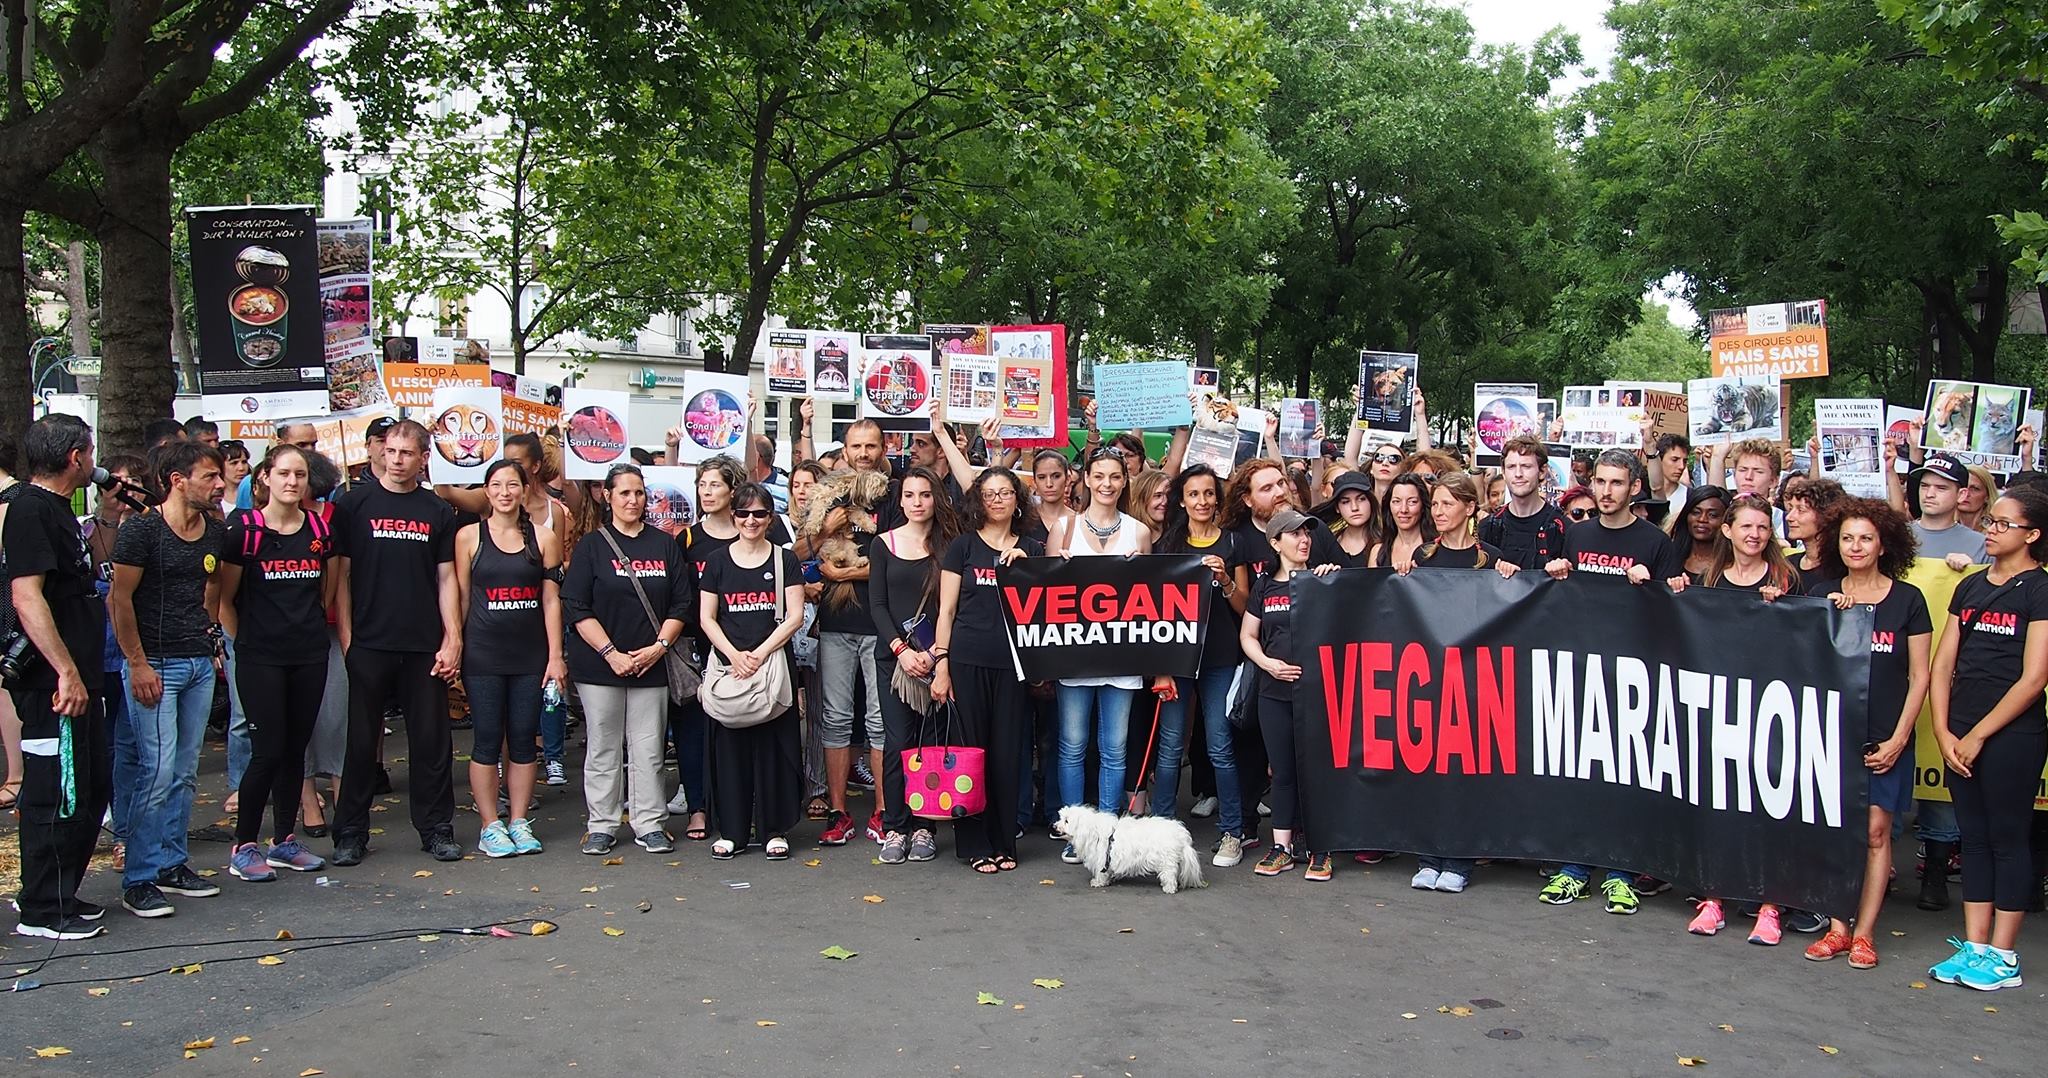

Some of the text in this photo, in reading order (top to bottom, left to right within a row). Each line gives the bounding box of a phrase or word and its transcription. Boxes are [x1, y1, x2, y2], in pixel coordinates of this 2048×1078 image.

[212, 219, 294, 228] CONSERVATION...
[275, 230, 296, 238] NON
[1719, 340, 1741, 351] DES
[1743, 336, 1792, 349] CIRQUES
[1719, 344, 1819, 365] MAIS SANS
[414, 367, 446, 377] STOP
[1722, 358, 1819, 378] ANIMAUX !
[391, 377, 483, 388] L'ESCLAVAGE
[511, 400, 547, 416] CIRQUES
[434, 431, 500, 442] Souffrance
[569, 438, 625, 449] Souffrance
[370, 519, 431, 534] VEGAN
[373, 530, 429, 542] MARATHON
[261, 559, 321, 572] VEGAN
[611, 559, 665, 571] VGAN
[1577, 551, 1634, 569] VEGAN
[1578, 563, 1627, 576] MARATHO
[1003, 584, 1200, 624] VEGAN
[1961, 609, 2016, 627] VGAN
[1016, 621, 1198, 648] MARATHON
[1318, 642, 1842, 828] VEGAN MARATHON
